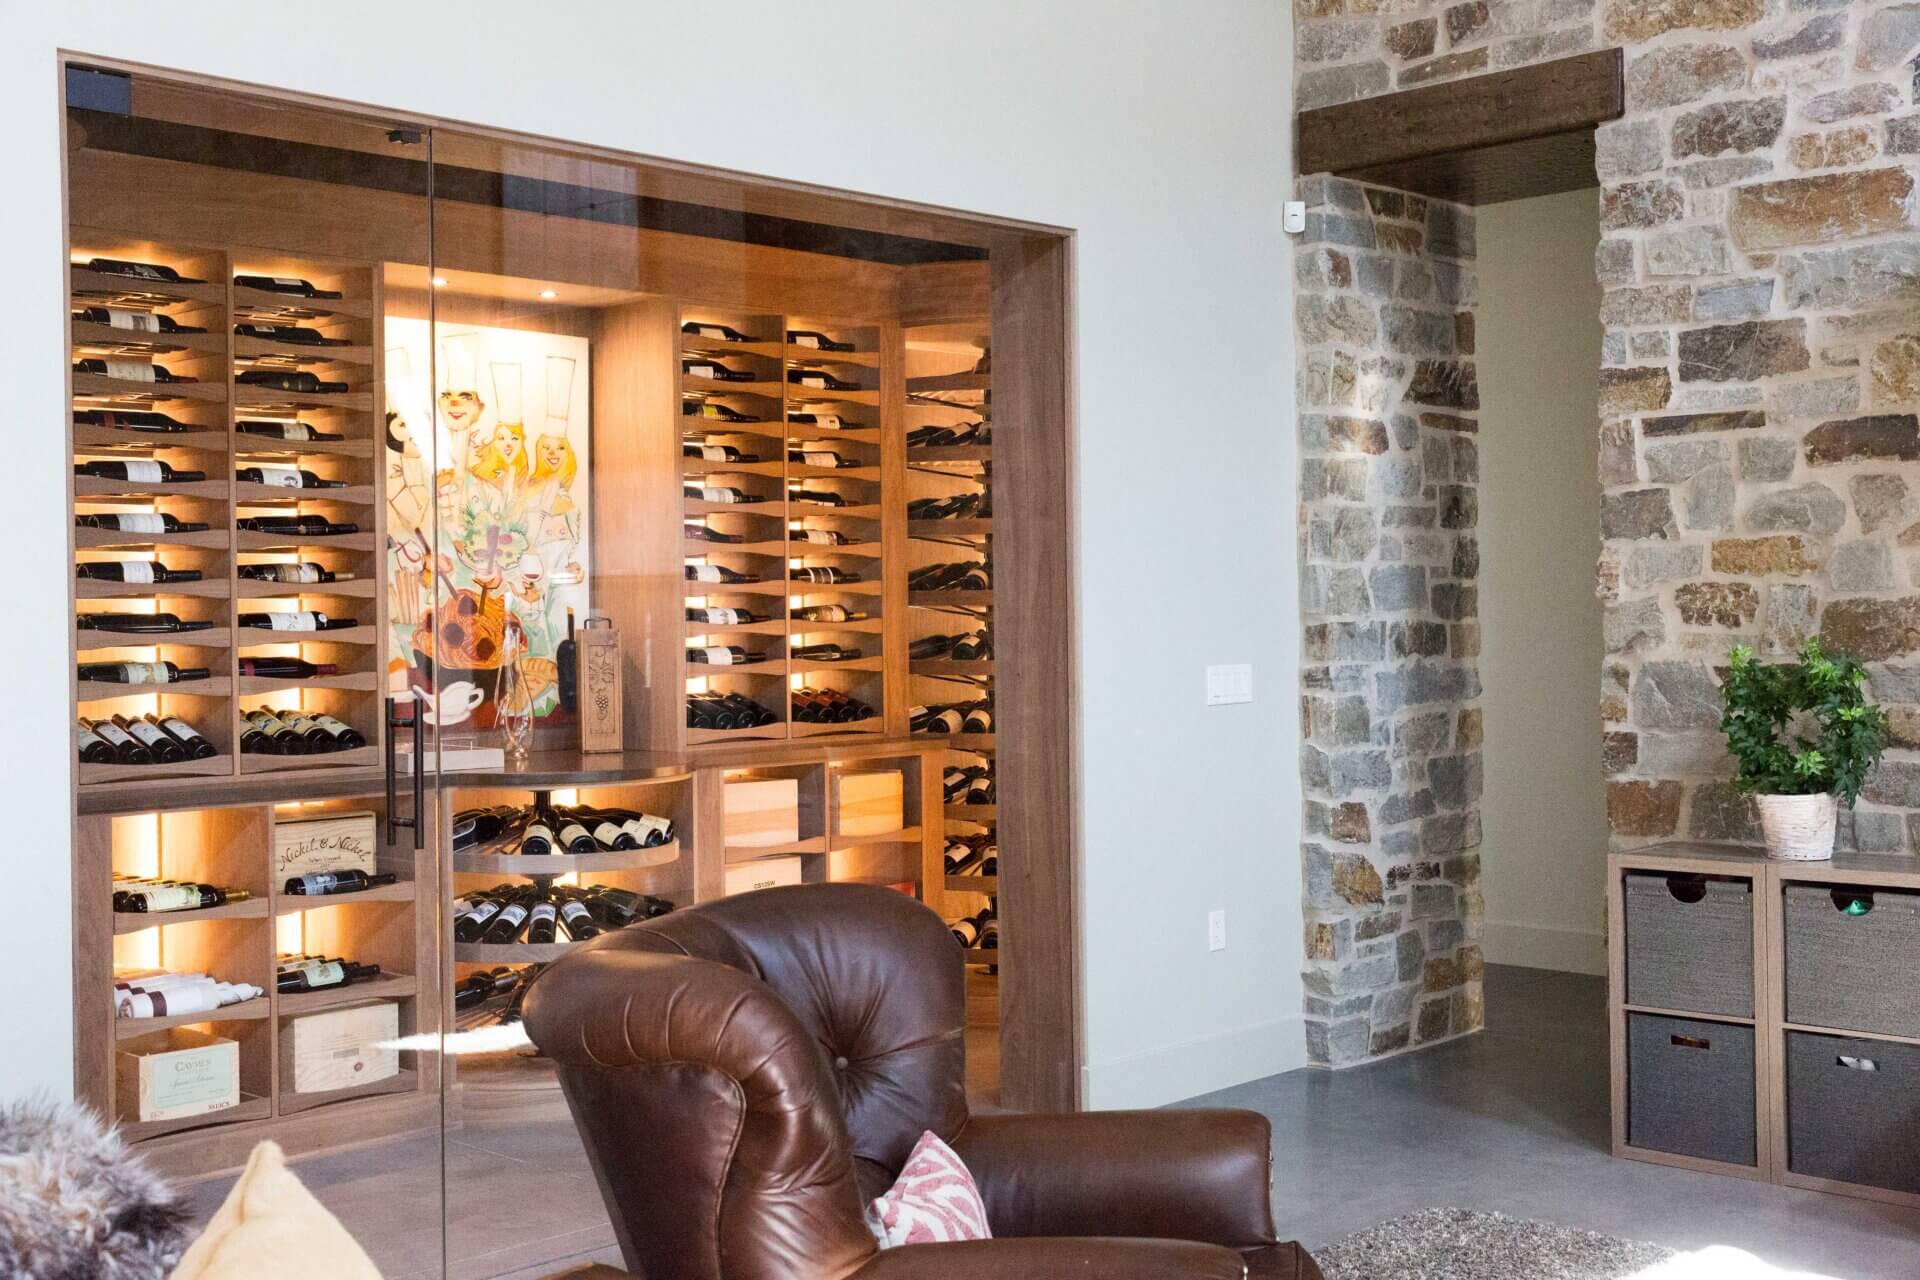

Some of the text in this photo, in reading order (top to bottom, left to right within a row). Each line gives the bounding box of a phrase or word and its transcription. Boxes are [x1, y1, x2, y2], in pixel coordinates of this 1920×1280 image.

[280, 836, 371, 871] Nickel & Nickel
